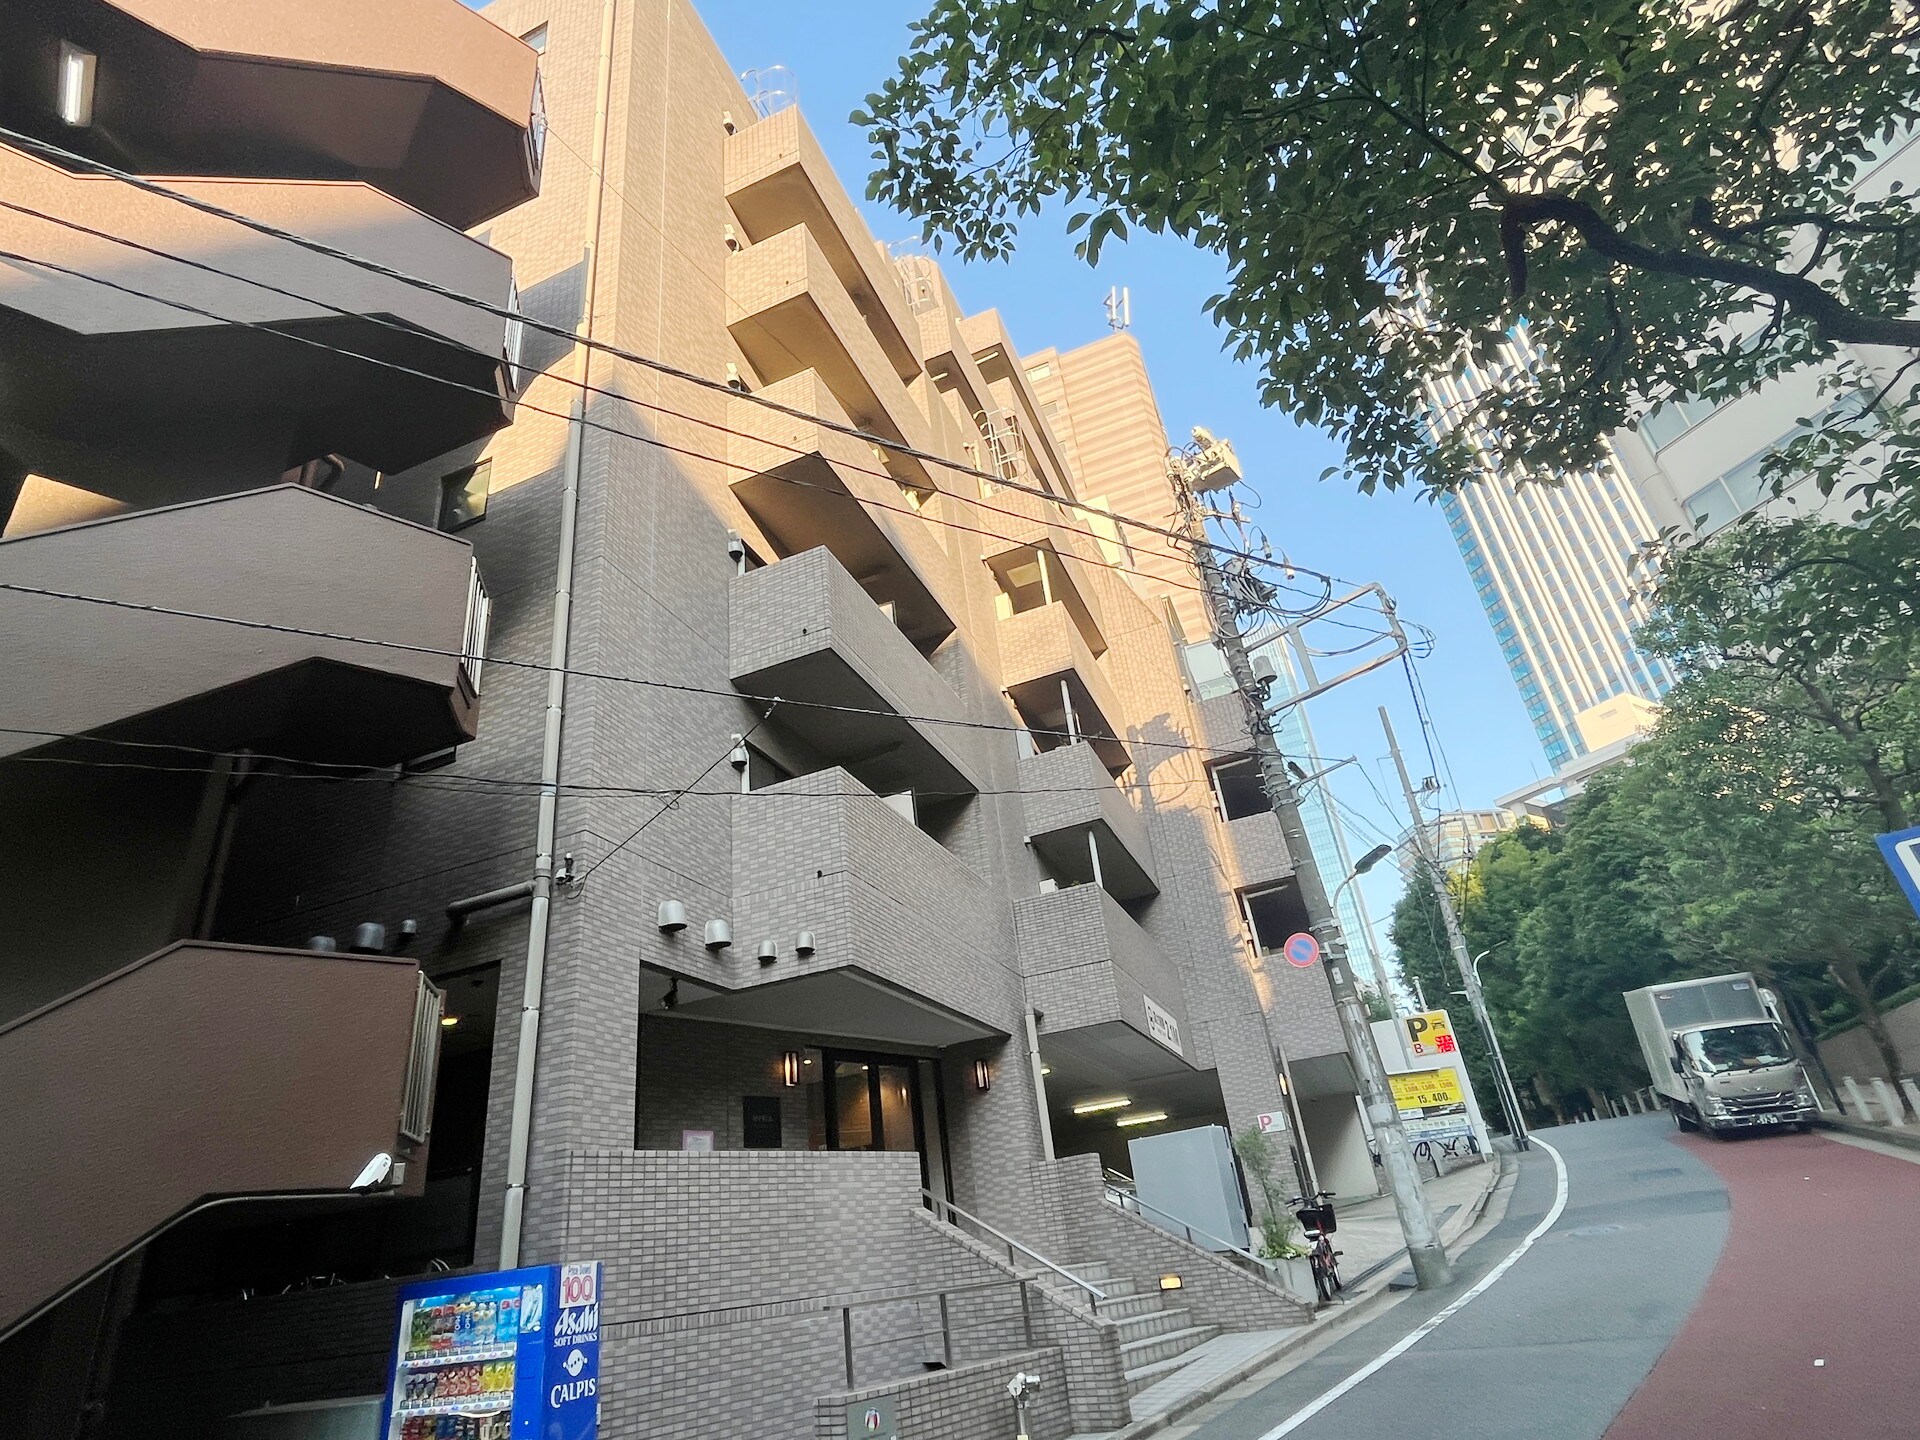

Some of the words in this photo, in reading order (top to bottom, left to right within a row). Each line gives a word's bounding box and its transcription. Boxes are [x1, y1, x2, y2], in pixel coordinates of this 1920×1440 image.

[1406, 1018, 1428, 1042] P
[1260, 1116, 1272, 1131] P
[563, 1275, 594, 1303] 100
[554, 1302, 599, 1336] Asahi
[553, 1336, 571, 1347] SOFT
[573, 1332, 598, 1344] DRINKS
[550, 1378, 596, 1408] CALPIS
